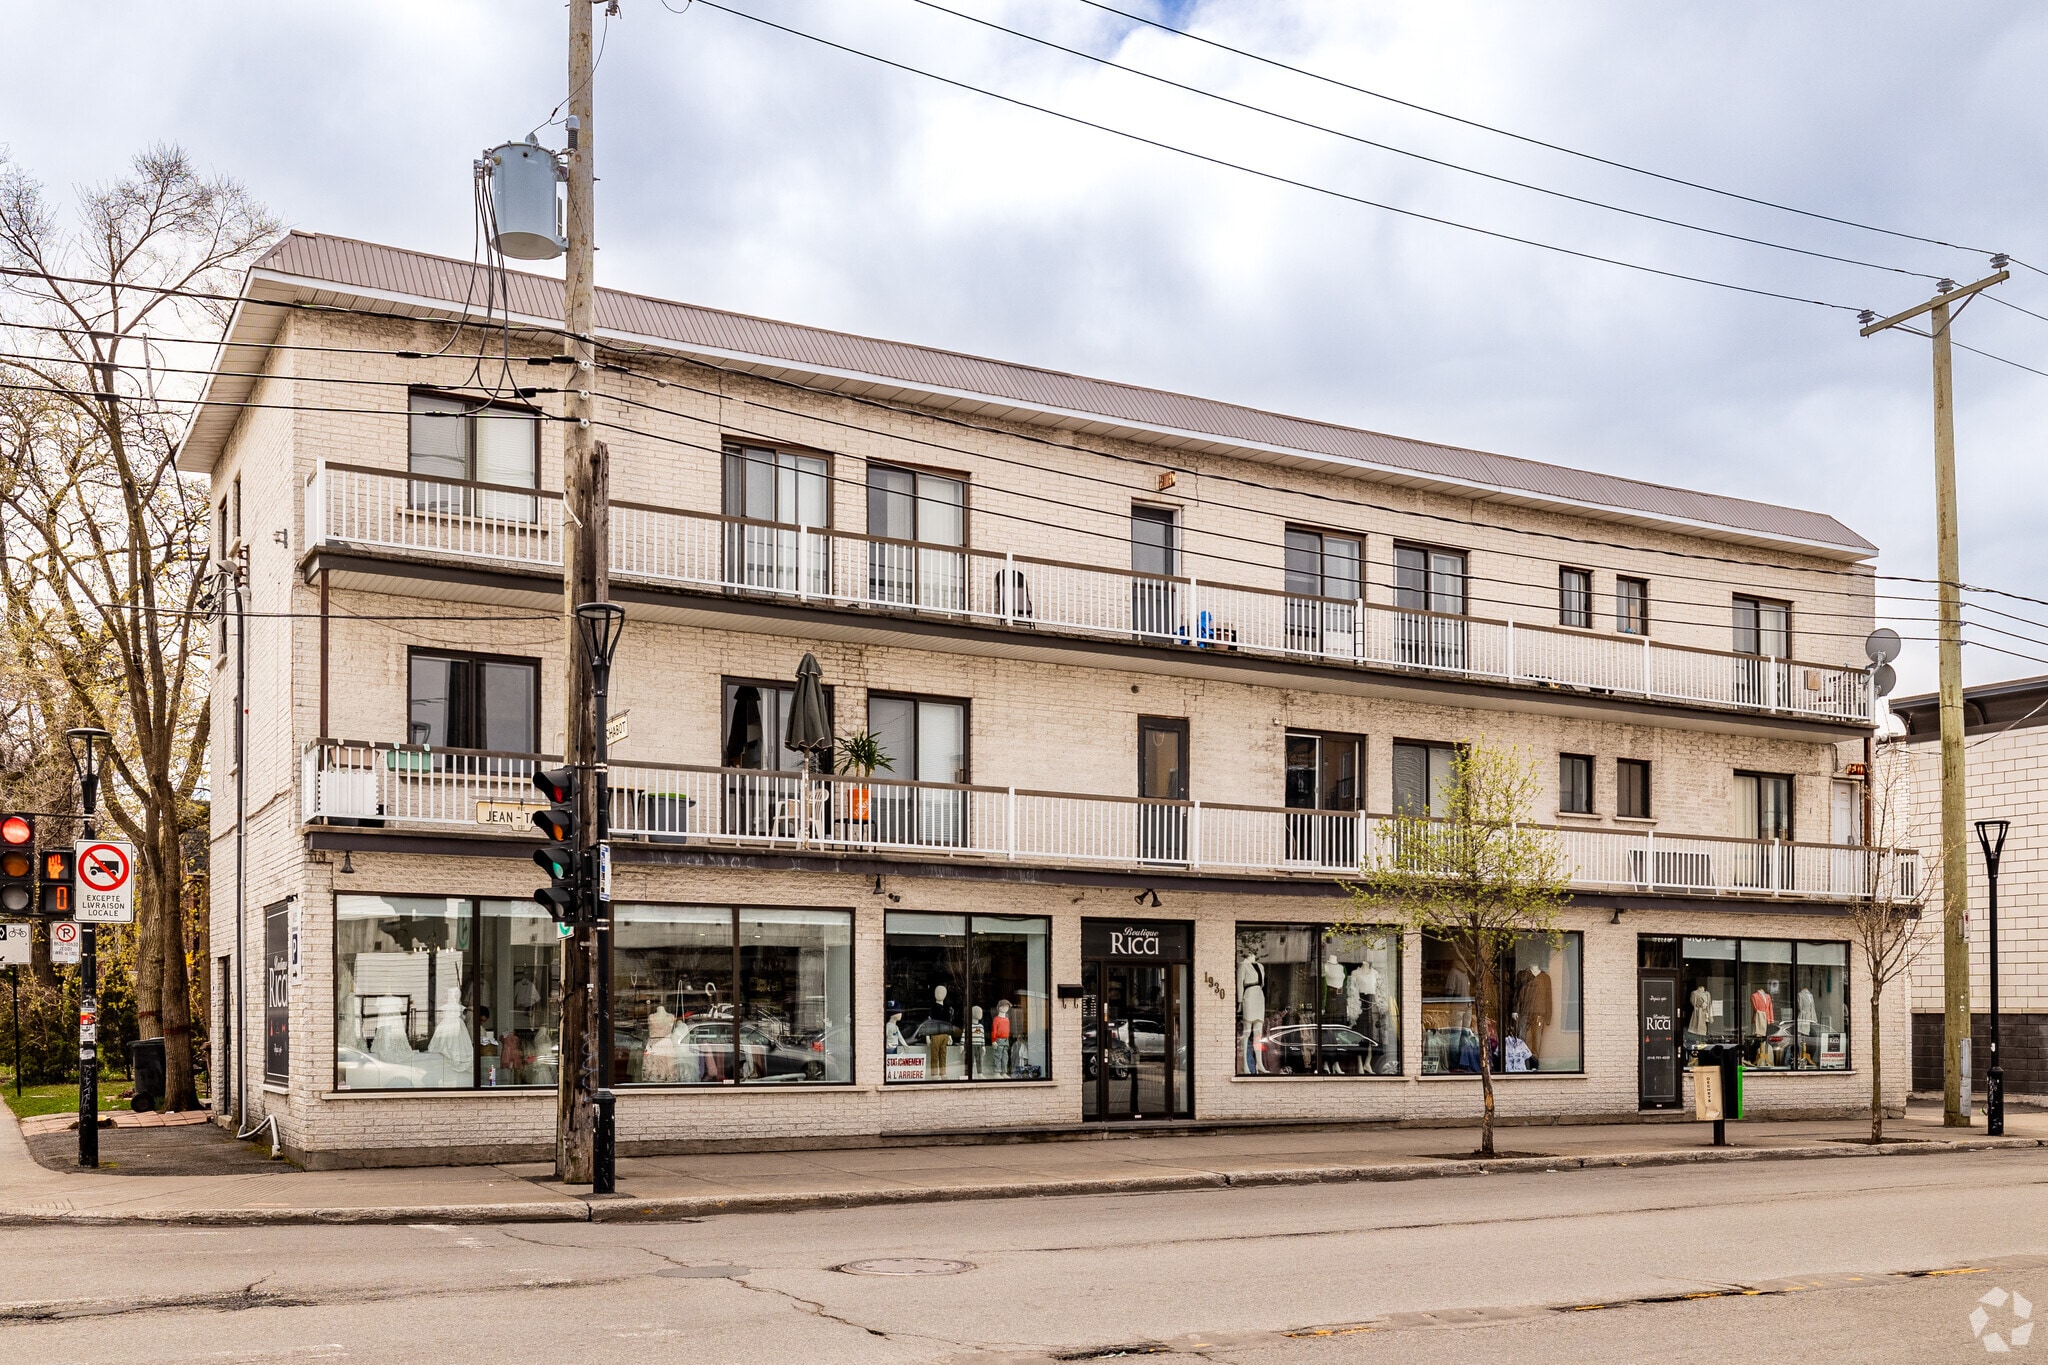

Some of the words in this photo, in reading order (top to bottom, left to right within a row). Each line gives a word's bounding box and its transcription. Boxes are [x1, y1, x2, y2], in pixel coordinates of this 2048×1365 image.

[88, 909, 119, 917] LOCALE
[1123, 926, 1160, 938] Boutique
[1204, 971, 1225, 1000] 1930
